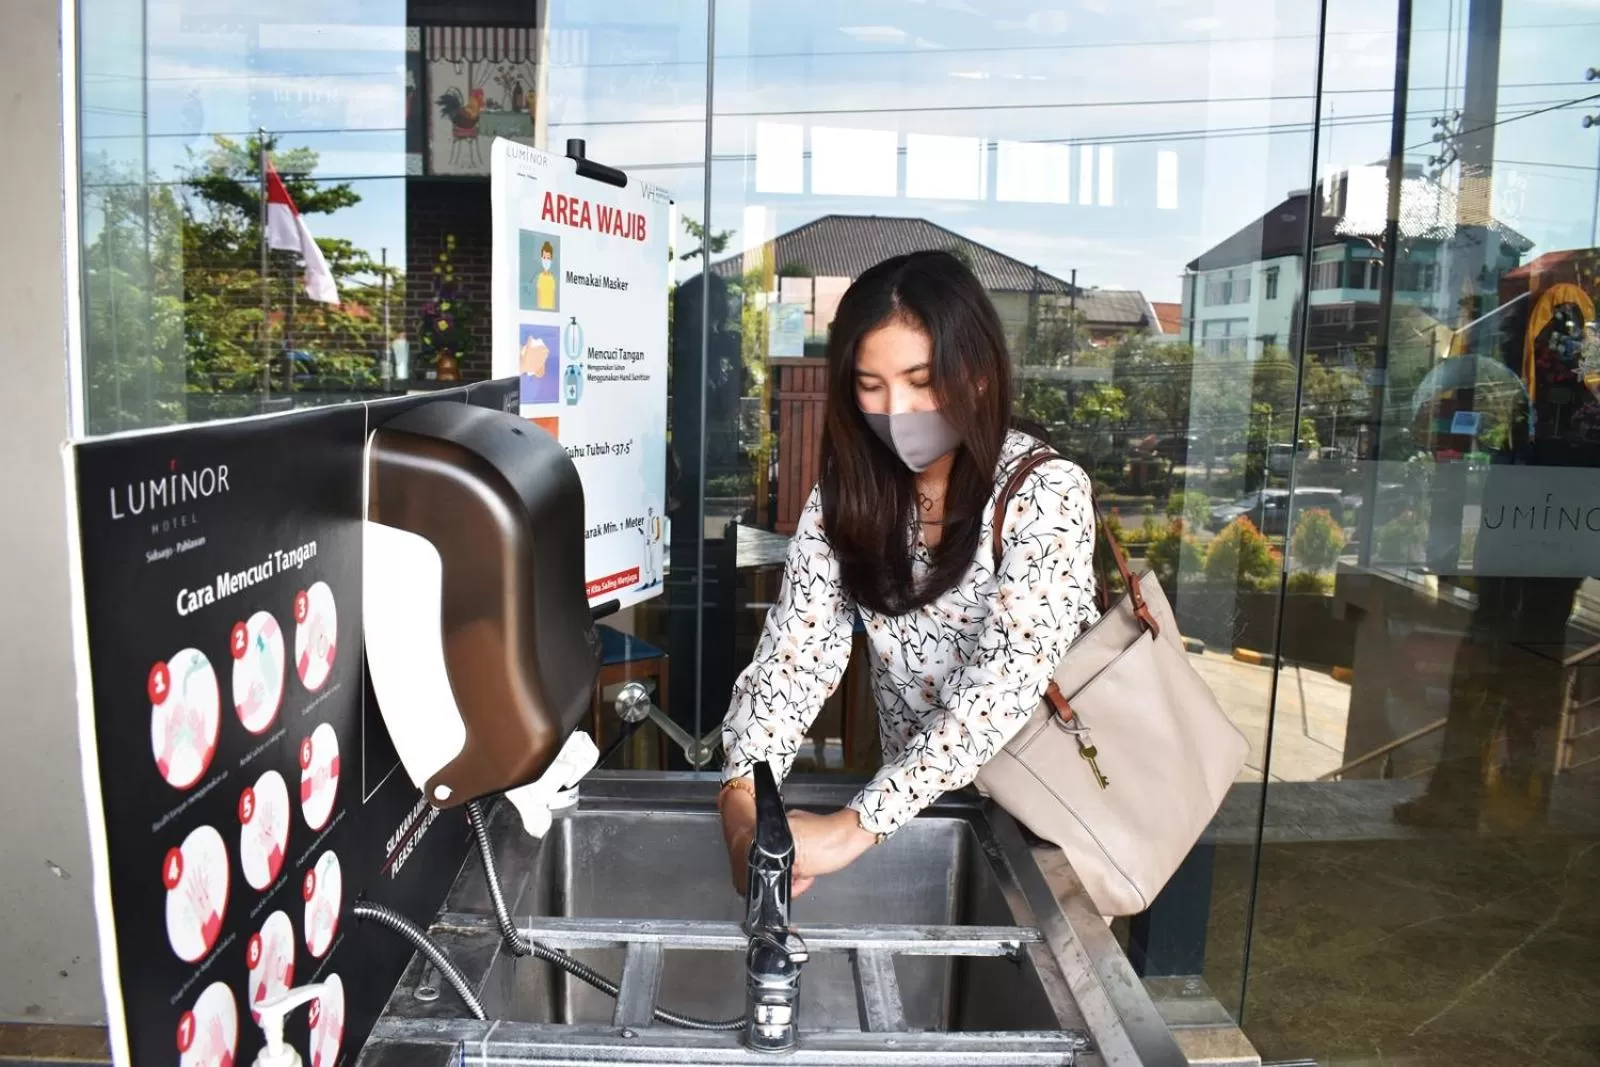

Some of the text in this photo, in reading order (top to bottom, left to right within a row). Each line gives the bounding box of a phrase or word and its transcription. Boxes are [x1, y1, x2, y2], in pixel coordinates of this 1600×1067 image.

[541, 191, 647, 242] AREA WAJIB
[566, 271, 629, 292] Memakai Masker
[588, 347, 645, 364] Mencuci Tangan
[586, 441, 610, 456] Tubuh
[151, 512, 199, 535] HOTEL
[585, 524, 602, 539] arak
[603, 521, 619, 535] Min.
[625, 516, 645, 529] Meter
[176, 540, 318, 617] Cara Mencuci Tangan
[297, 597, 306, 617] 3
[235, 629, 245, 650] 2
[154, 671, 166, 693] 1
[242, 794, 251, 818] 5
[386, 811, 413, 858] SILAKAN
[168, 855, 179, 881] 4
[391, 836, 414, 880] PLEASE
[306, 876, 313, 894] 9
[251, 941, 258, 961] 8
